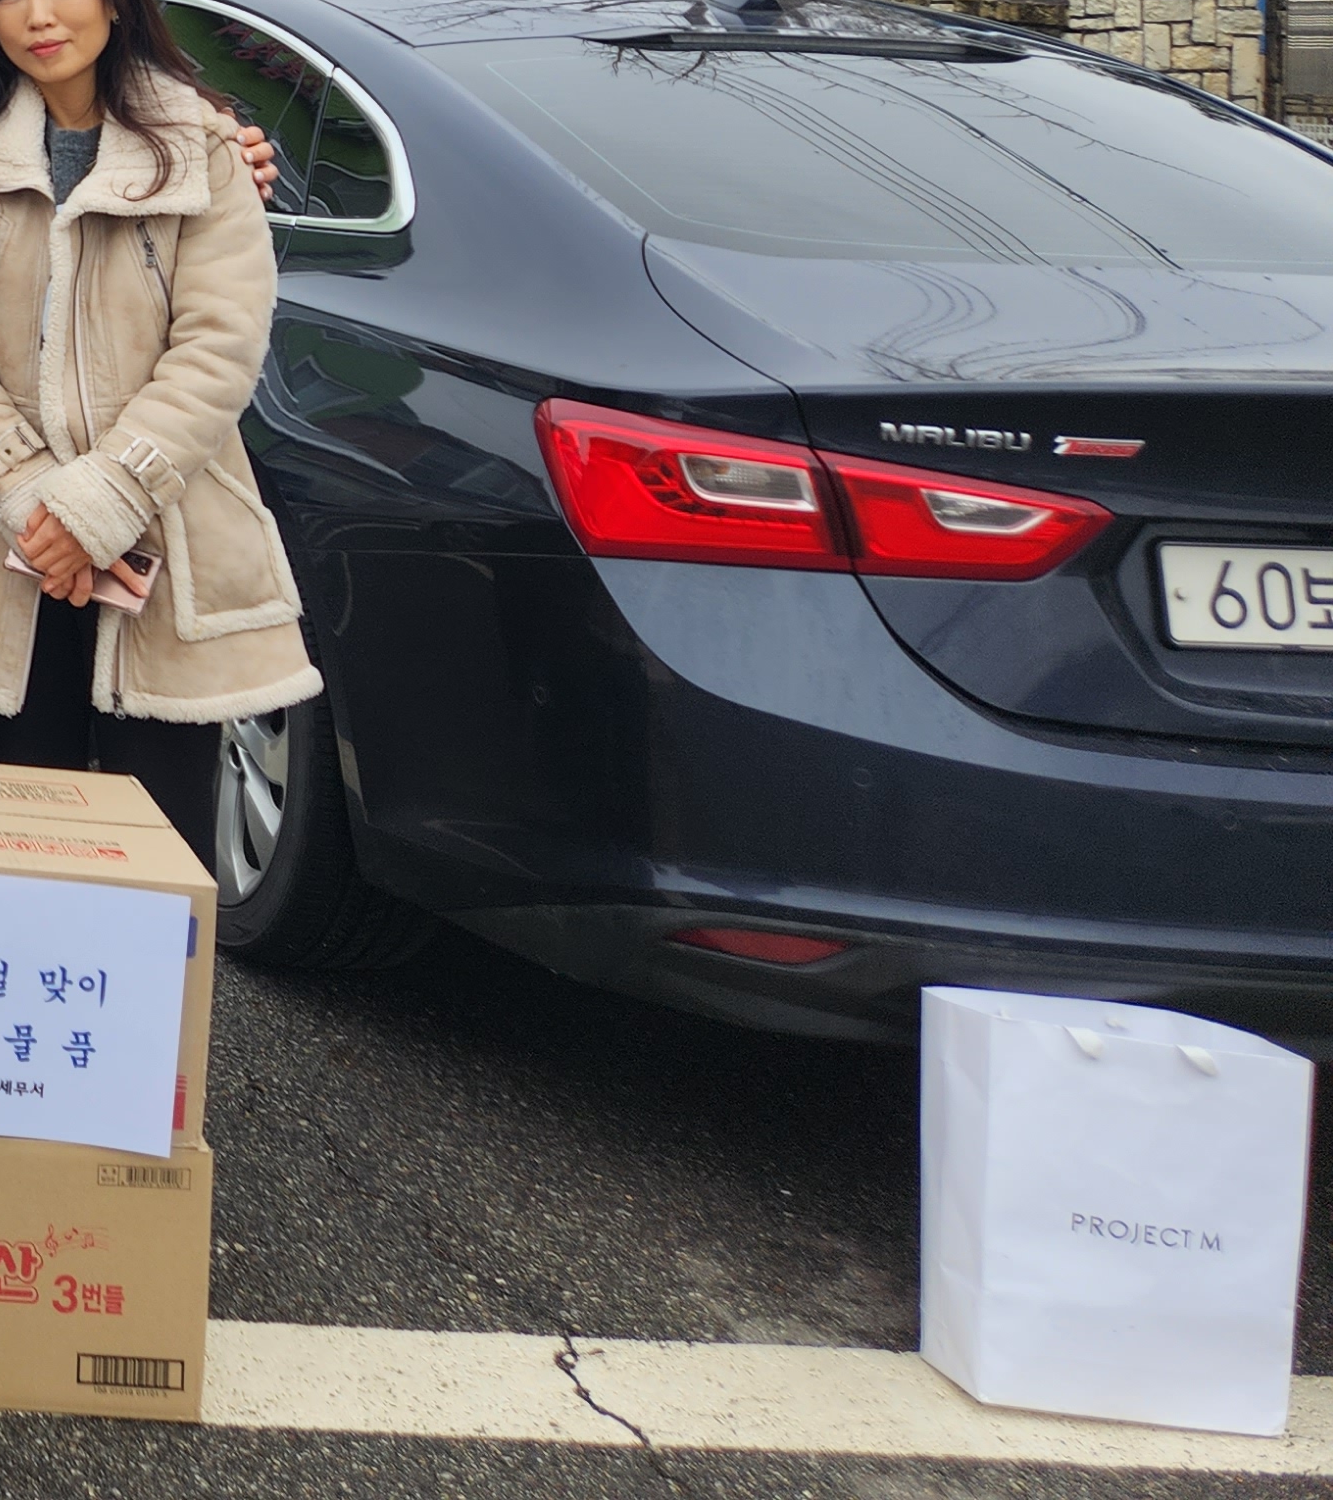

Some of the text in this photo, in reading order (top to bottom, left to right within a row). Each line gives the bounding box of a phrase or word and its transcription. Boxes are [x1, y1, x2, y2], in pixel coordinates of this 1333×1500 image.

[879, 420, 1033, 452] MALIBU
[38, 965, 108, 1008] 맞이
[1070, 1211, 1222, 1252] PROJECT M
